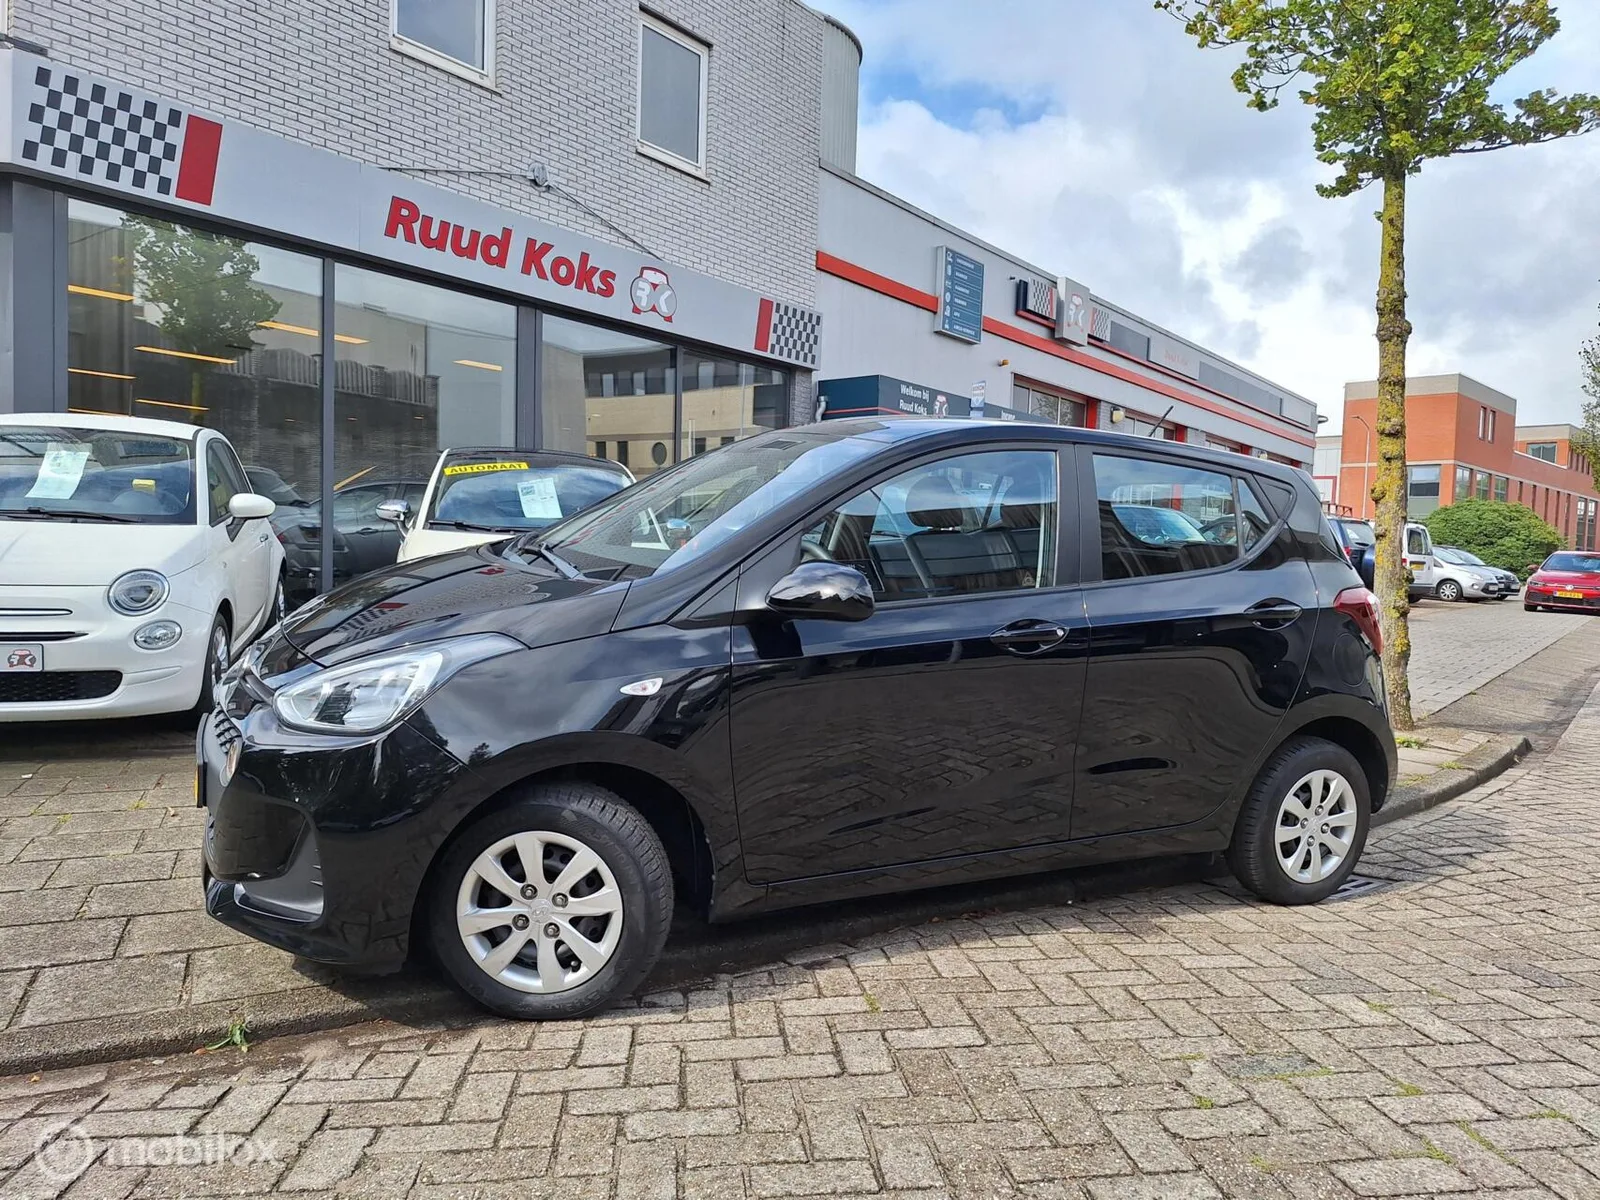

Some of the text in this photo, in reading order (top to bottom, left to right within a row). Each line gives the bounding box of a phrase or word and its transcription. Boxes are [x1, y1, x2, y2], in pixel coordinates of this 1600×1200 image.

[384, 195, 617, 298] Ruud Koks
[900, 383, 930, 403] Welkom bij
[899, 399, 928, 416] Ruud Koks
[450, 463, 524, 474] AUTOMAAT
